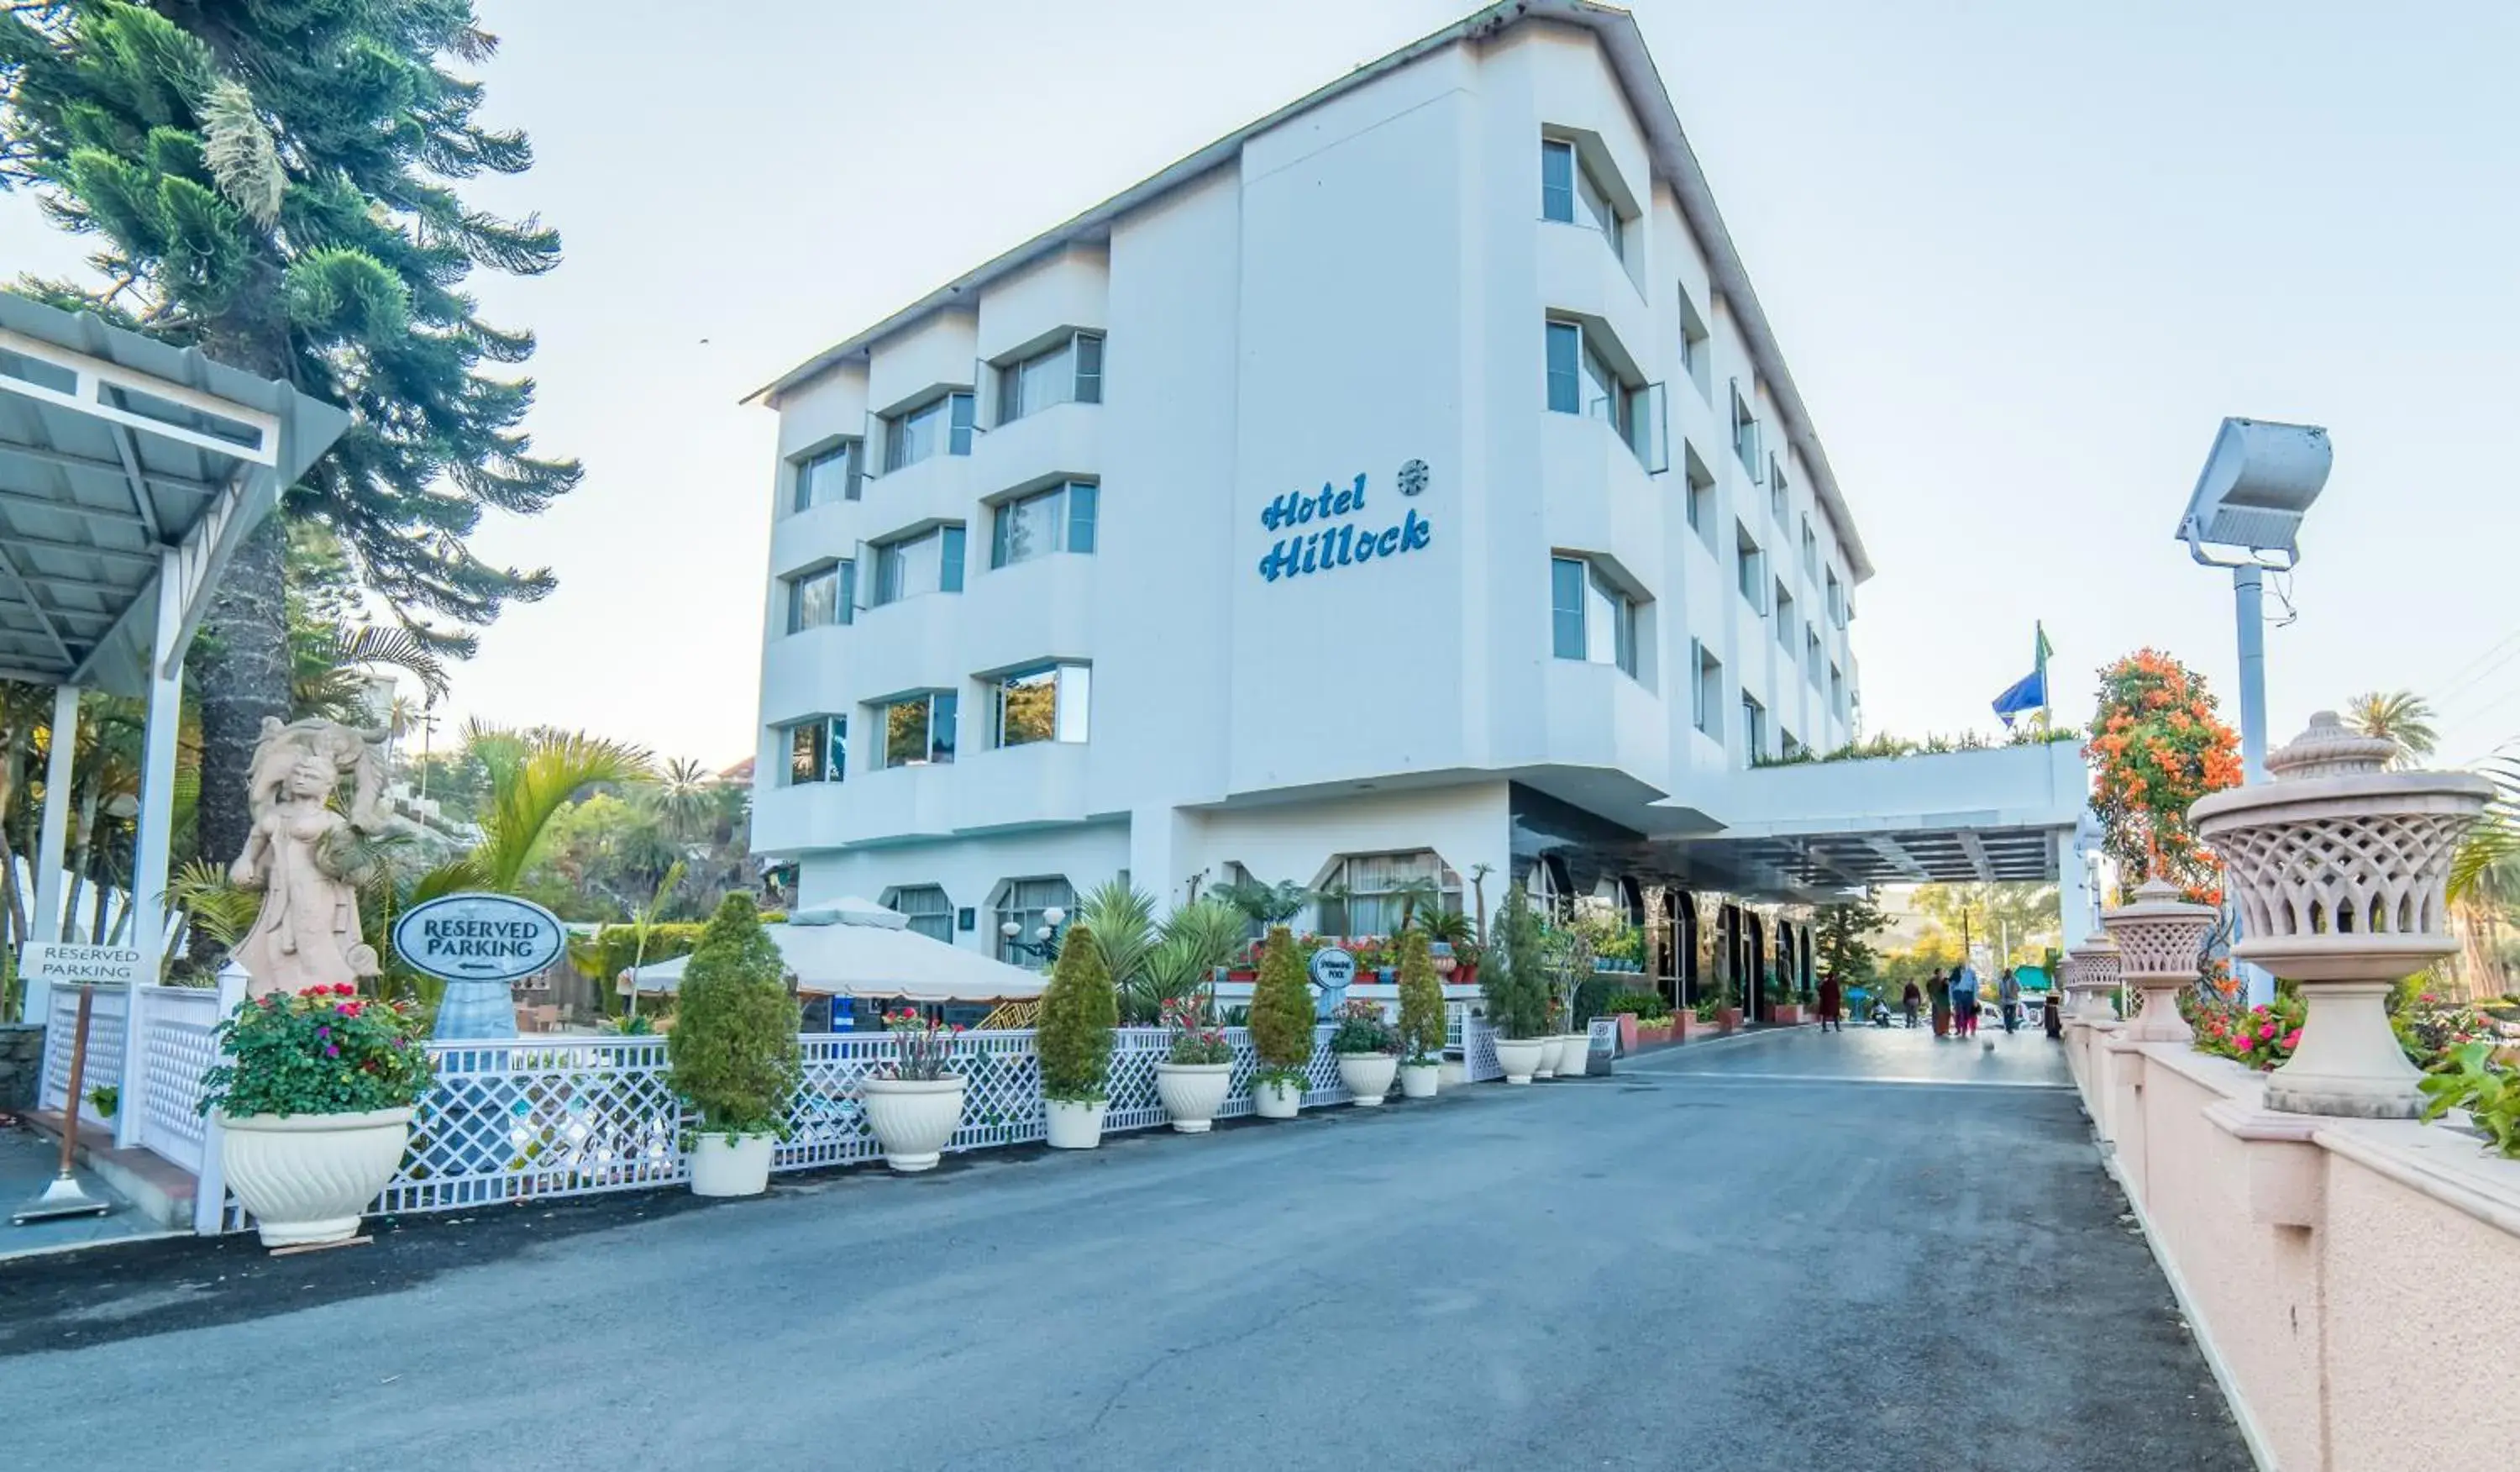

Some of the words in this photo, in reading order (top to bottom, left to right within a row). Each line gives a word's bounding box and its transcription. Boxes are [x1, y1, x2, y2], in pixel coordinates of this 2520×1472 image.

[1262, 472, 1367, 532] Hotel
[1259, 508, 1431, 581] Hillock
[424, 920, 538, 938] RESERVED
[45, 947, 139, 962] RESERVED
[428, 938, 532, 956] PARKING
[42, 964, 130, 977] PARKING
